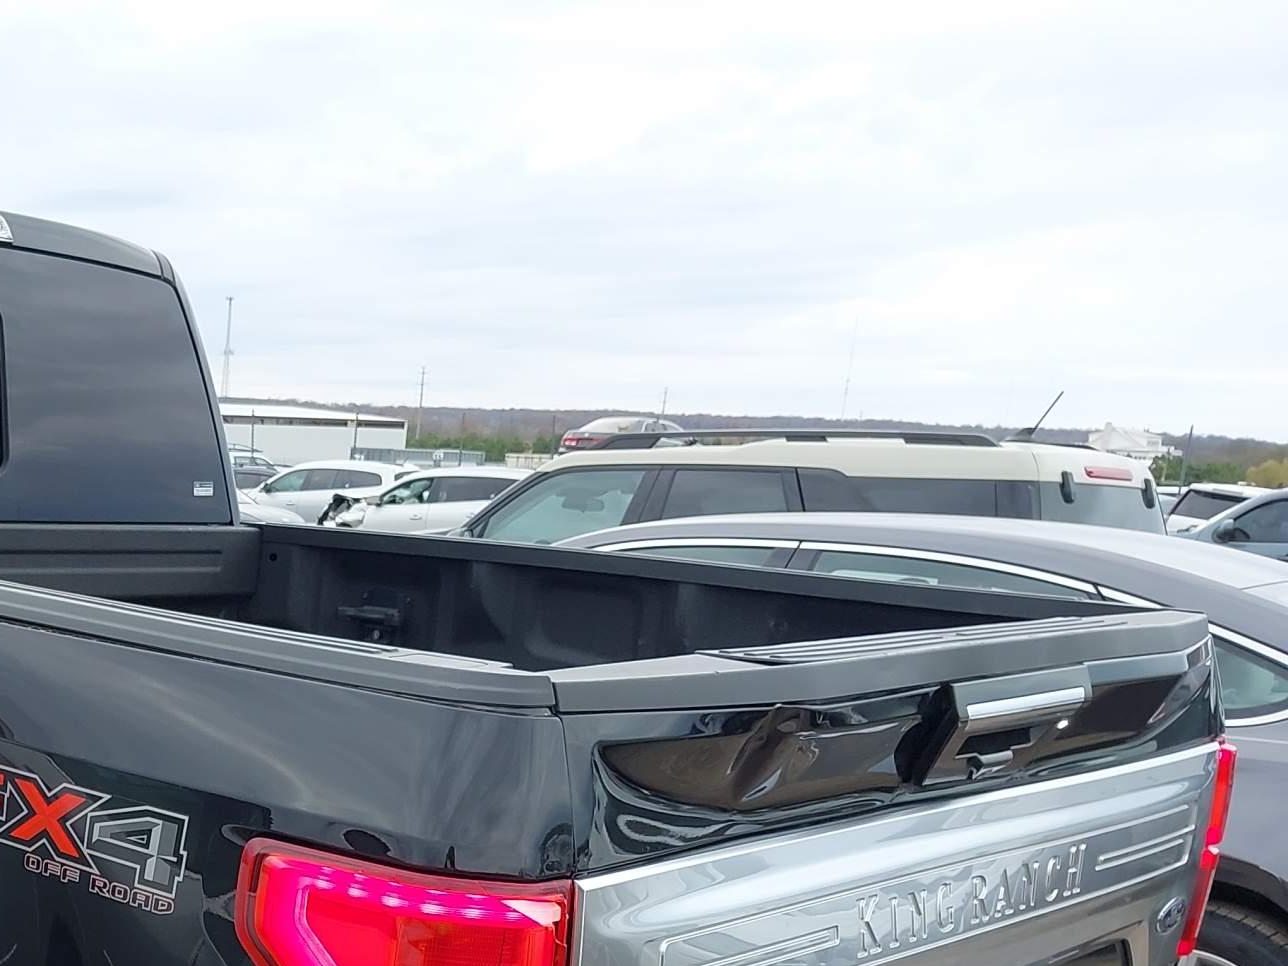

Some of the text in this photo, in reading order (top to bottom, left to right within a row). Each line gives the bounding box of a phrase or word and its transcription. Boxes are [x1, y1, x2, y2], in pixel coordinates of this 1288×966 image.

[24, 852, 175, 915] OFF ROAD
[855, 880, 955, 959] KING
[969, 843, 1088, 926] RANCH
